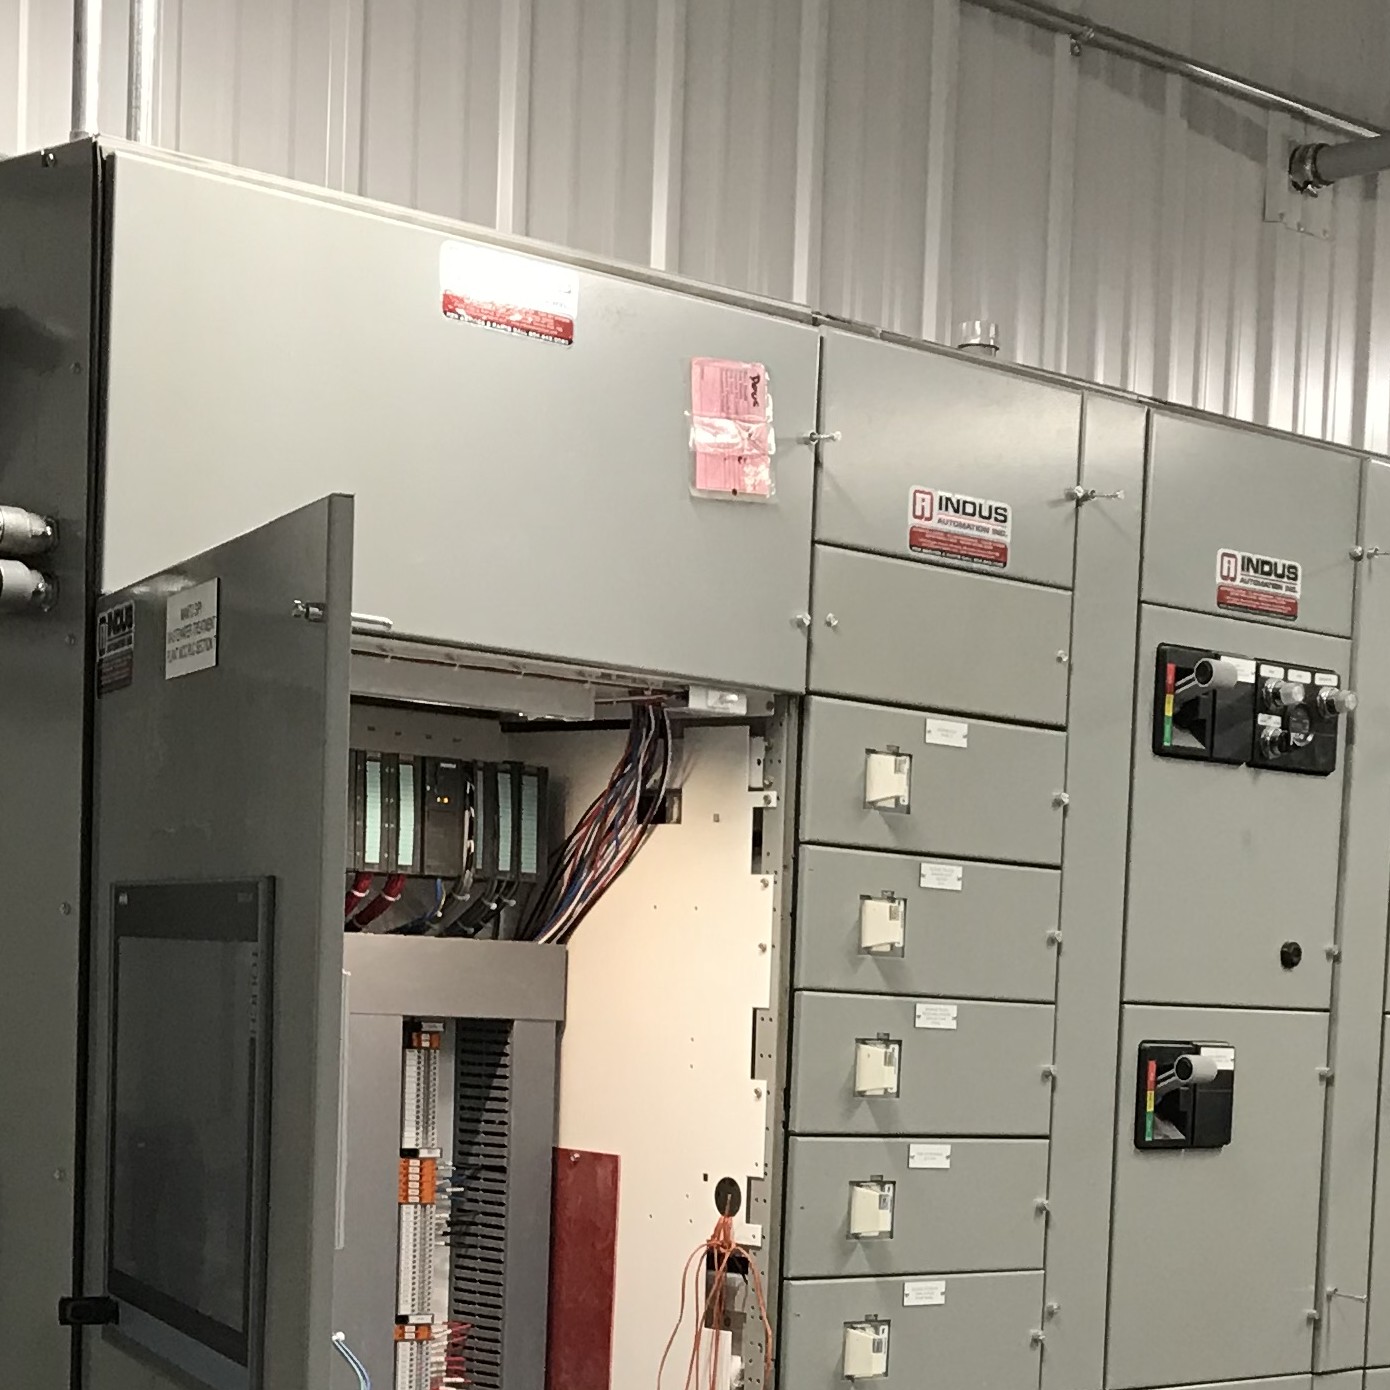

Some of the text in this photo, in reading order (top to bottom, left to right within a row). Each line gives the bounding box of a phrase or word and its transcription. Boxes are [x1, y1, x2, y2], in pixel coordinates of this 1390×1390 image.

[938, 495, 1008, 523] INDUS
[937, 518, 990, 533] AUTOMATION
[1240, 555, 1299, 581] INDUS
